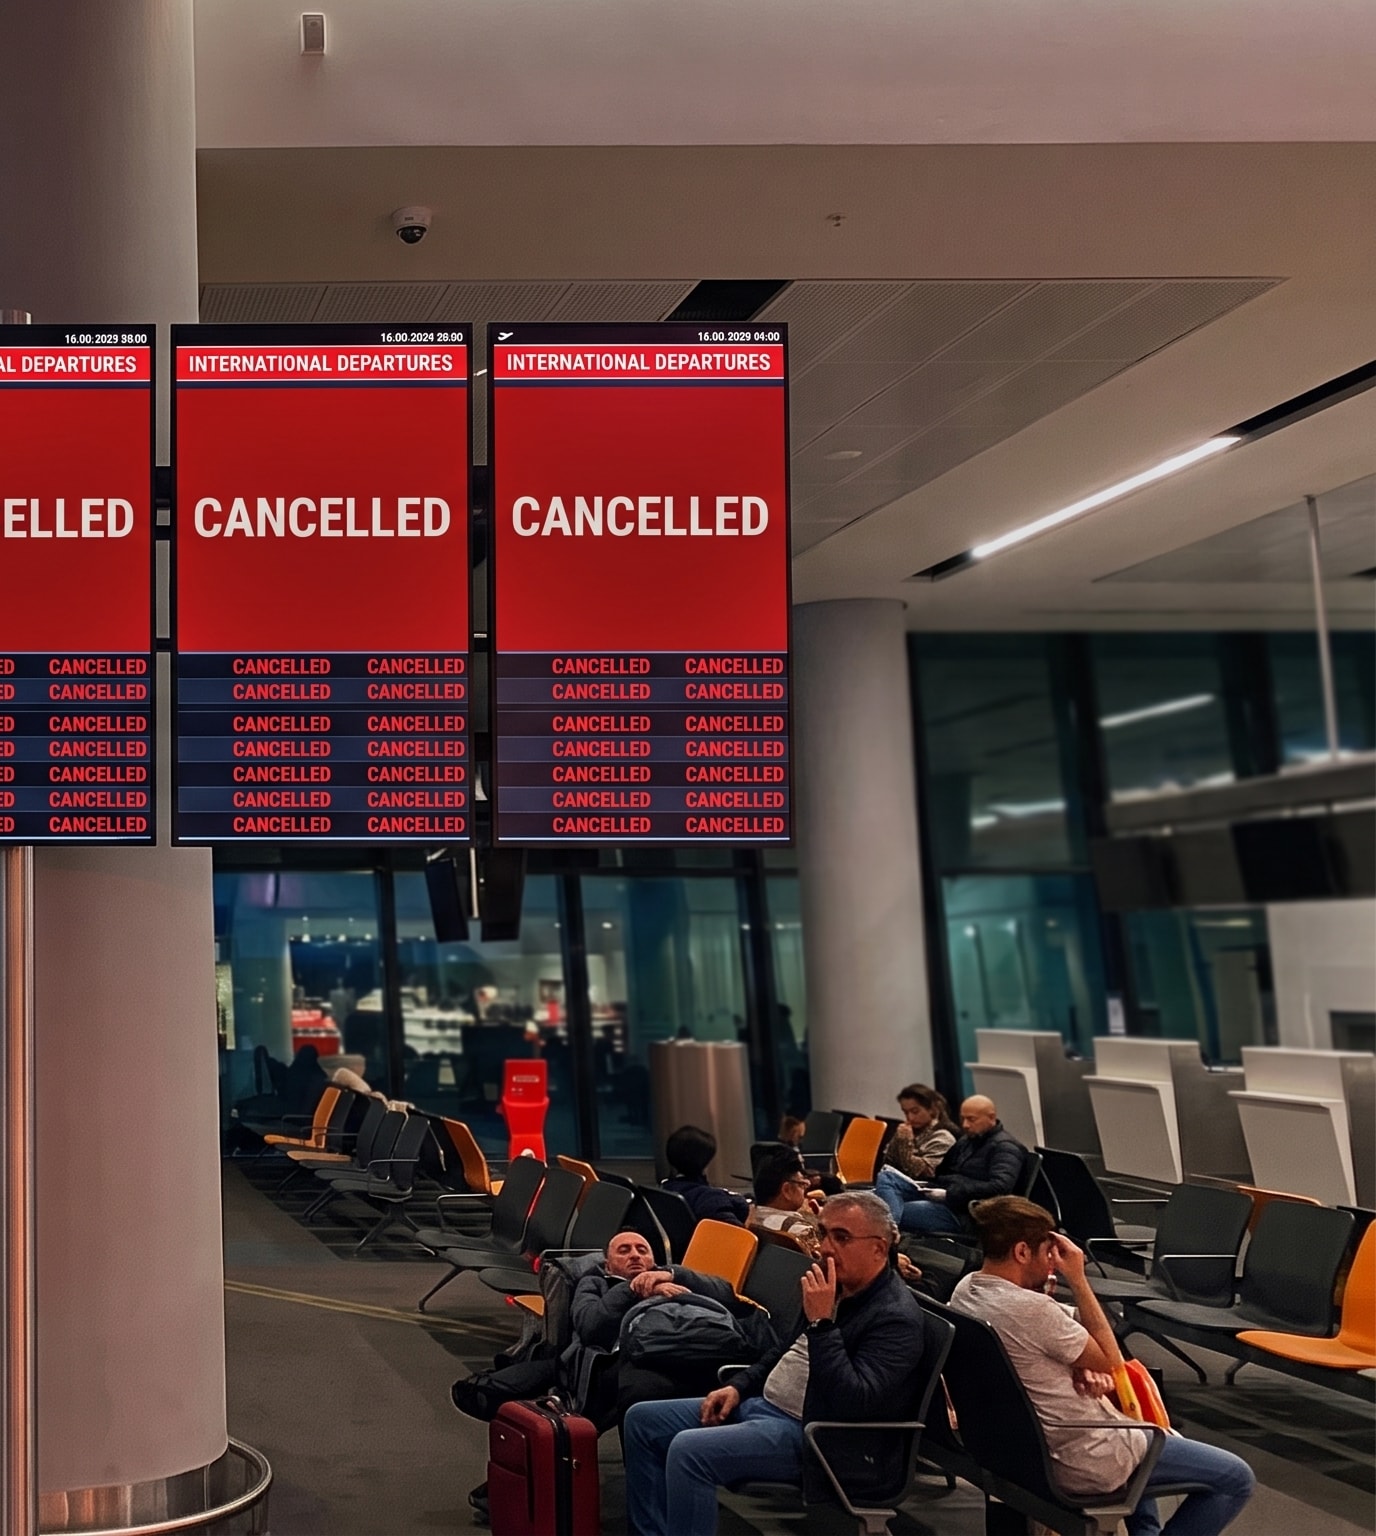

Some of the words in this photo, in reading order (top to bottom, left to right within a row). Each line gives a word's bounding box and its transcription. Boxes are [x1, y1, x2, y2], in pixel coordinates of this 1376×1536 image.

[753, 331, 780, 342] 04:00
[21, 355, 137, 373] DEPARTURES
[189, 354, 333, 372] INTERNATIONAL
[337, 354, 453, 372] DEPARTURES
[507, 353, 651, 371] INTERNATIONAL
[655, 353, 771, 371] DEPARTURES
[194, 496, 451, 538] CANCELLED
[512, 495, 769, 537] CANCELLED
[48, 658, 147, 675] CANCELLED
[232, 658, 331, 675] CANCELLED
[367, 658, 465, 675] CANCELLED
[551, 657, 651, 675] CANCELLED
[684, 657, 784, 675] CANCELLED
[49, 683, 147, 700] CANCELLED
[232, 683, 331, 700] CANCELLED
[367, 683, 465, 700] CANCELLED
[551, 683, 651, 700] CANCELLED
[685, 683, 785, 700] CANCELLED
[49, 716, 147, 732] CANCELLED
[232, 716, 331, 732] CANCELLED
[367, 715, 465, 732] CANCELLED
[552, 715, 651, 732] CANCELLED
[685, 715, 784, 732] CANCELLED
[49, 740, 147, 757] CANCELLED
[232, 740, 331, 757] CANCELLED
[367, 740, 466, 757] CANCELLED
[552, 740, 651, 757] CANCELLED
[685, 740, 785, 758] CANCELLED
[49, 766, 147, 783] CANCELLED
[233, 766, 332, 782] CANCELLED
[367, 766, 466, 782] CANCELLED
[552, 766, 651, 783] CANCELLED
[685, 766, 785, 783] CANCELLED
[48, 791, 147, 808] CANCELLED
[233, 791, 332, 808] CANCELLED
[367, 791, 466, 808] CANCELLED
[552, 791, 652, 808] CANCELLED
[685, 791, 785, 808] CANCELLED
[49, 816, 147, 833] CANCELLED
[233, 816, 332, 833] CANCELLED
[367, 816, 465, 833] CANCELLED
[552, 816, 652, 833] CANCELLED
[685, 816, 785, 833] CANCELLED
